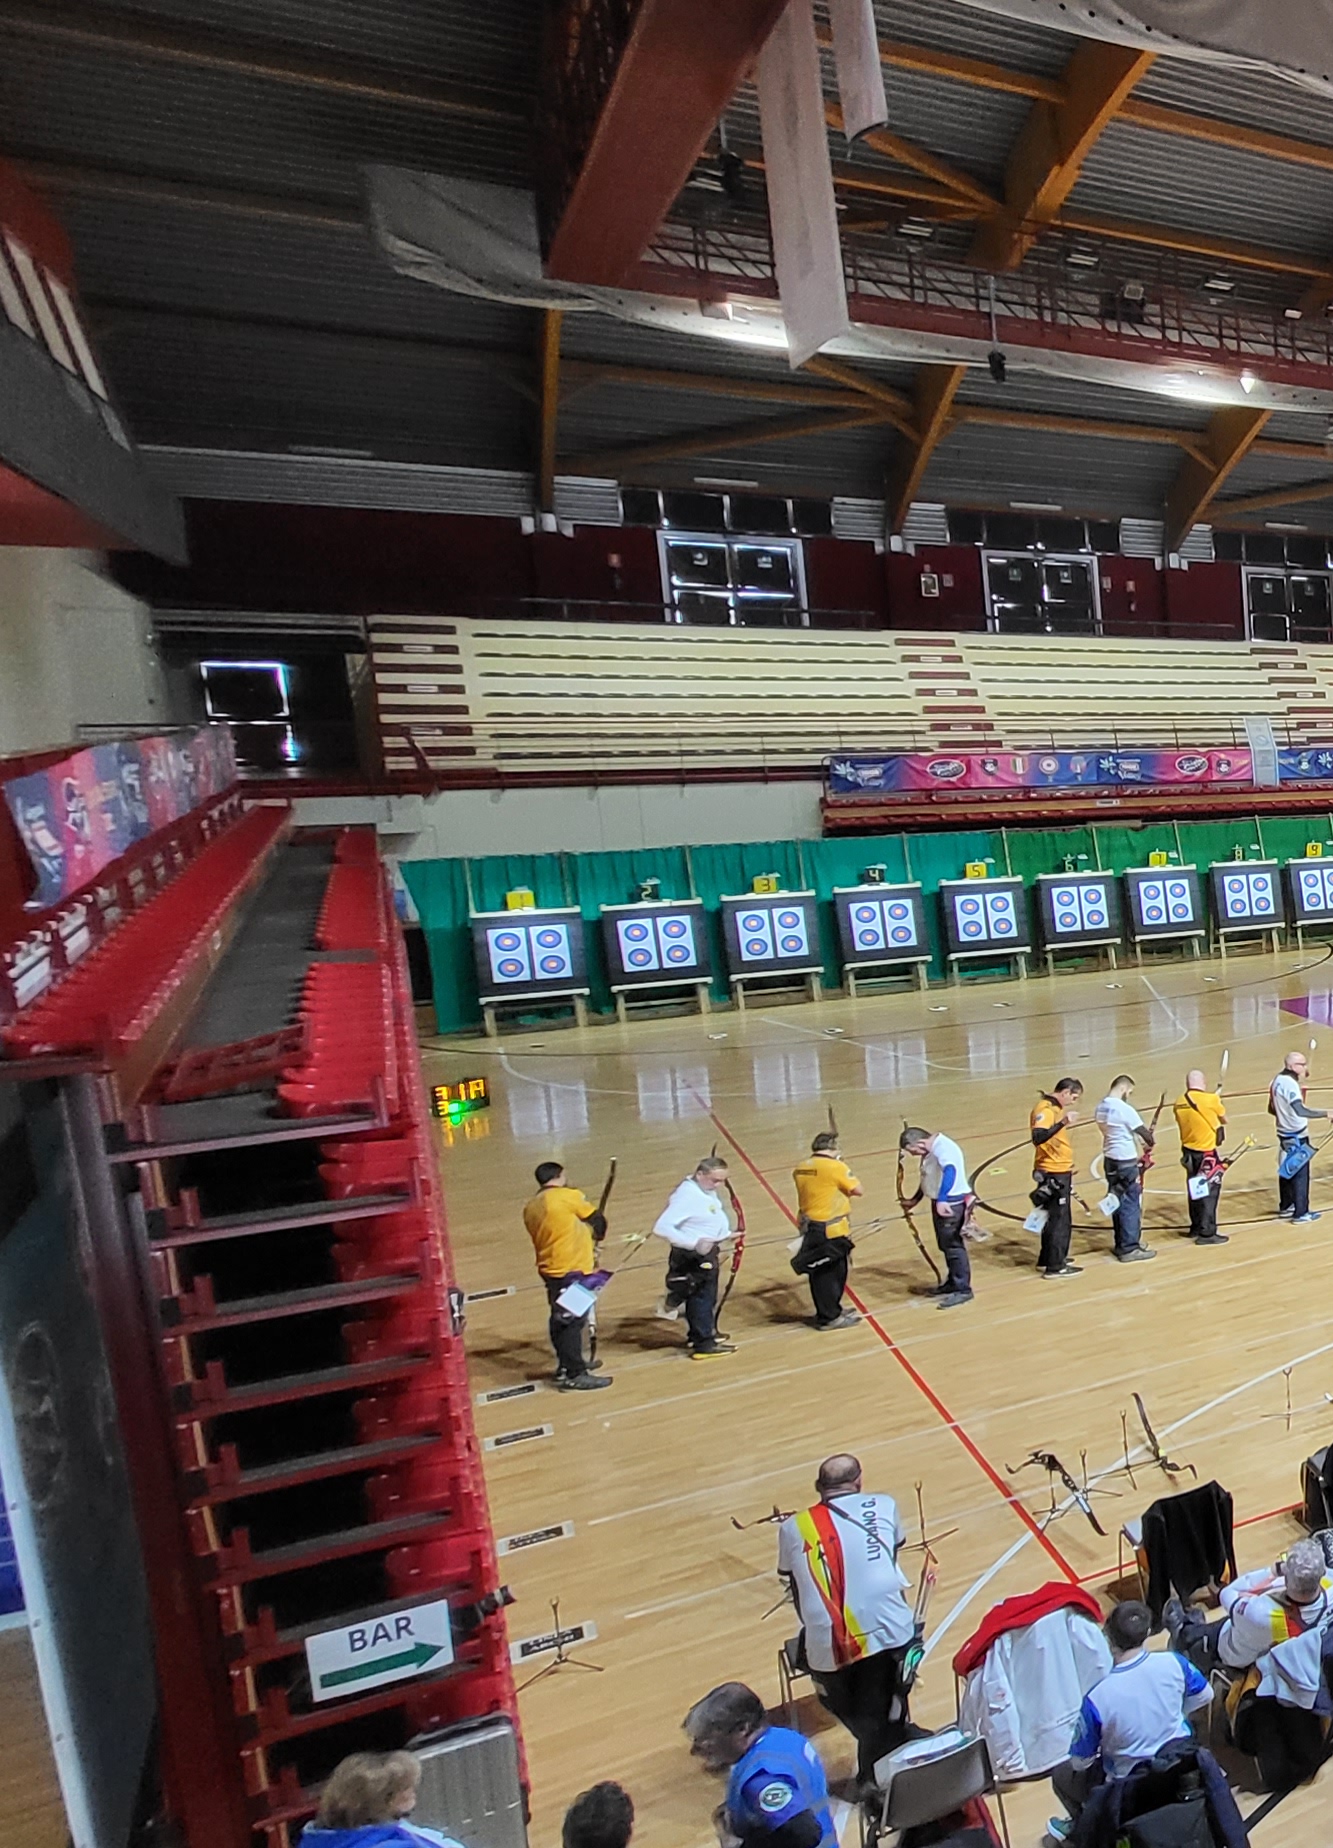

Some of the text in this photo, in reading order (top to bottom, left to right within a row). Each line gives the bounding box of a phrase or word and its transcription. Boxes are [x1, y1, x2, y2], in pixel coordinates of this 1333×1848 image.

[1311, 845, 1318, 856] 9
[973, 865, 980, 877] 5
[1065, 859, 1073, 872] 6
[870, 869, 879, 881] 4
[762, 878, 770, 892] 3
[641, 885, 650, 900] 2
[861, 1497, 881, 1562] LUCIANO G.
[348, 1616, 415, 1653] BAR
